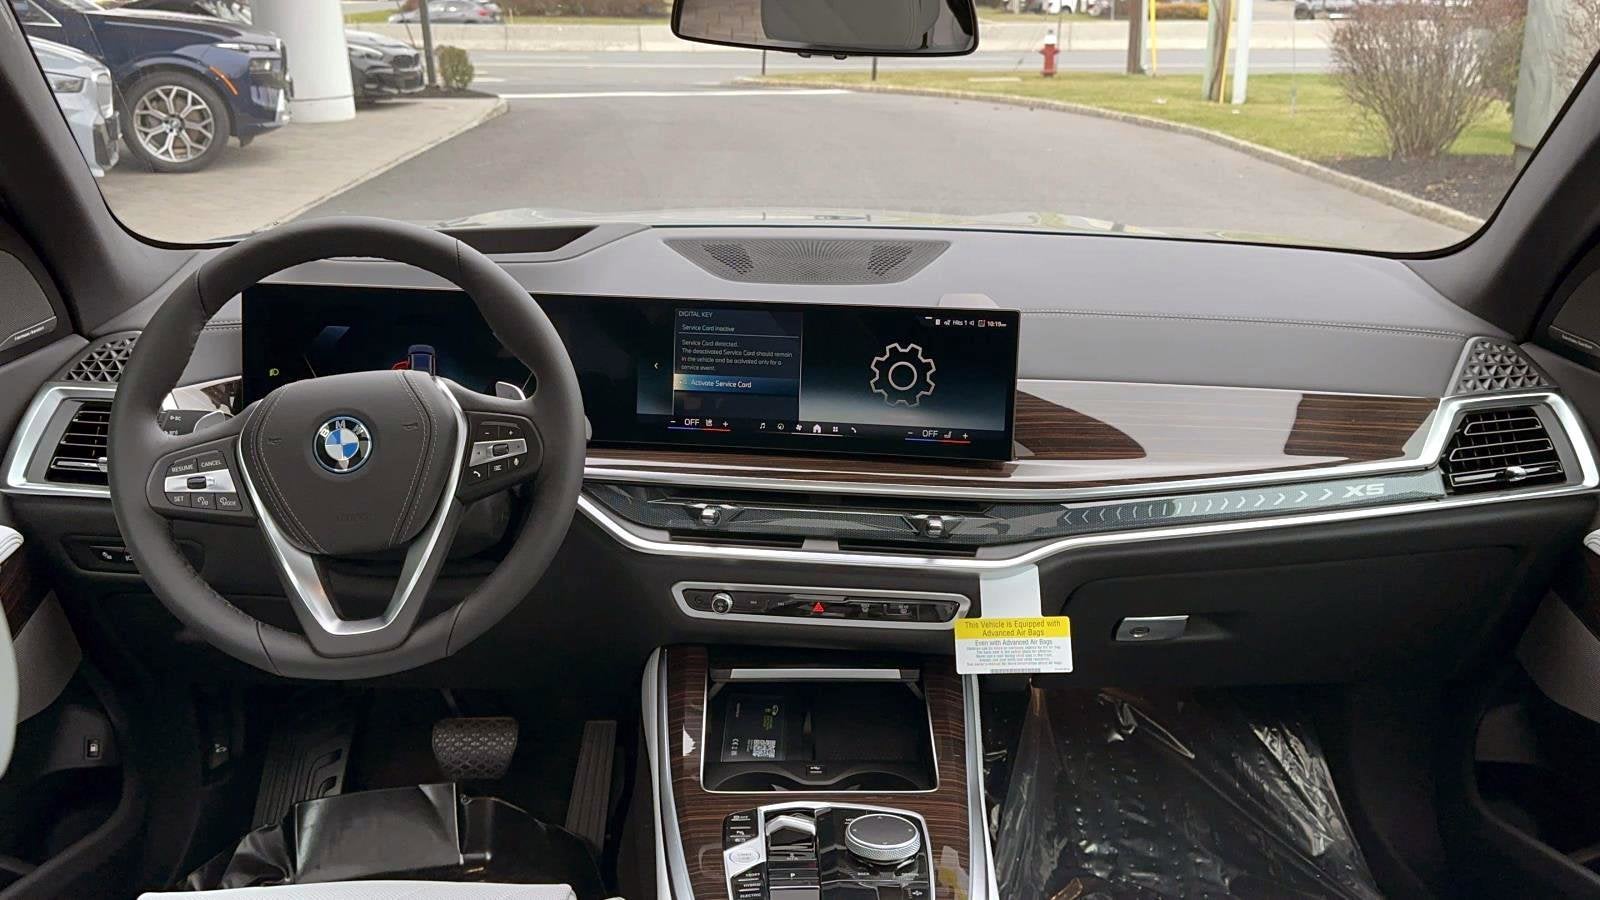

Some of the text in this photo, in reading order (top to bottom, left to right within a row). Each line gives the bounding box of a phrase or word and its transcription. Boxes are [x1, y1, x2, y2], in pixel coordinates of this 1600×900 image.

[690, 378, 714, 386] Activate
[320, 419, 368, 438] BMW
[172, 464, 194, 472] RESUME
[1342, 483, 1385, 498] X5
[1014, 620, 1045, 629] Equipped
[1047, 619, 1061, 627] with
[982, 629, 1014, 637] Advanced
[1028, 628, 1044, 637] Bags
